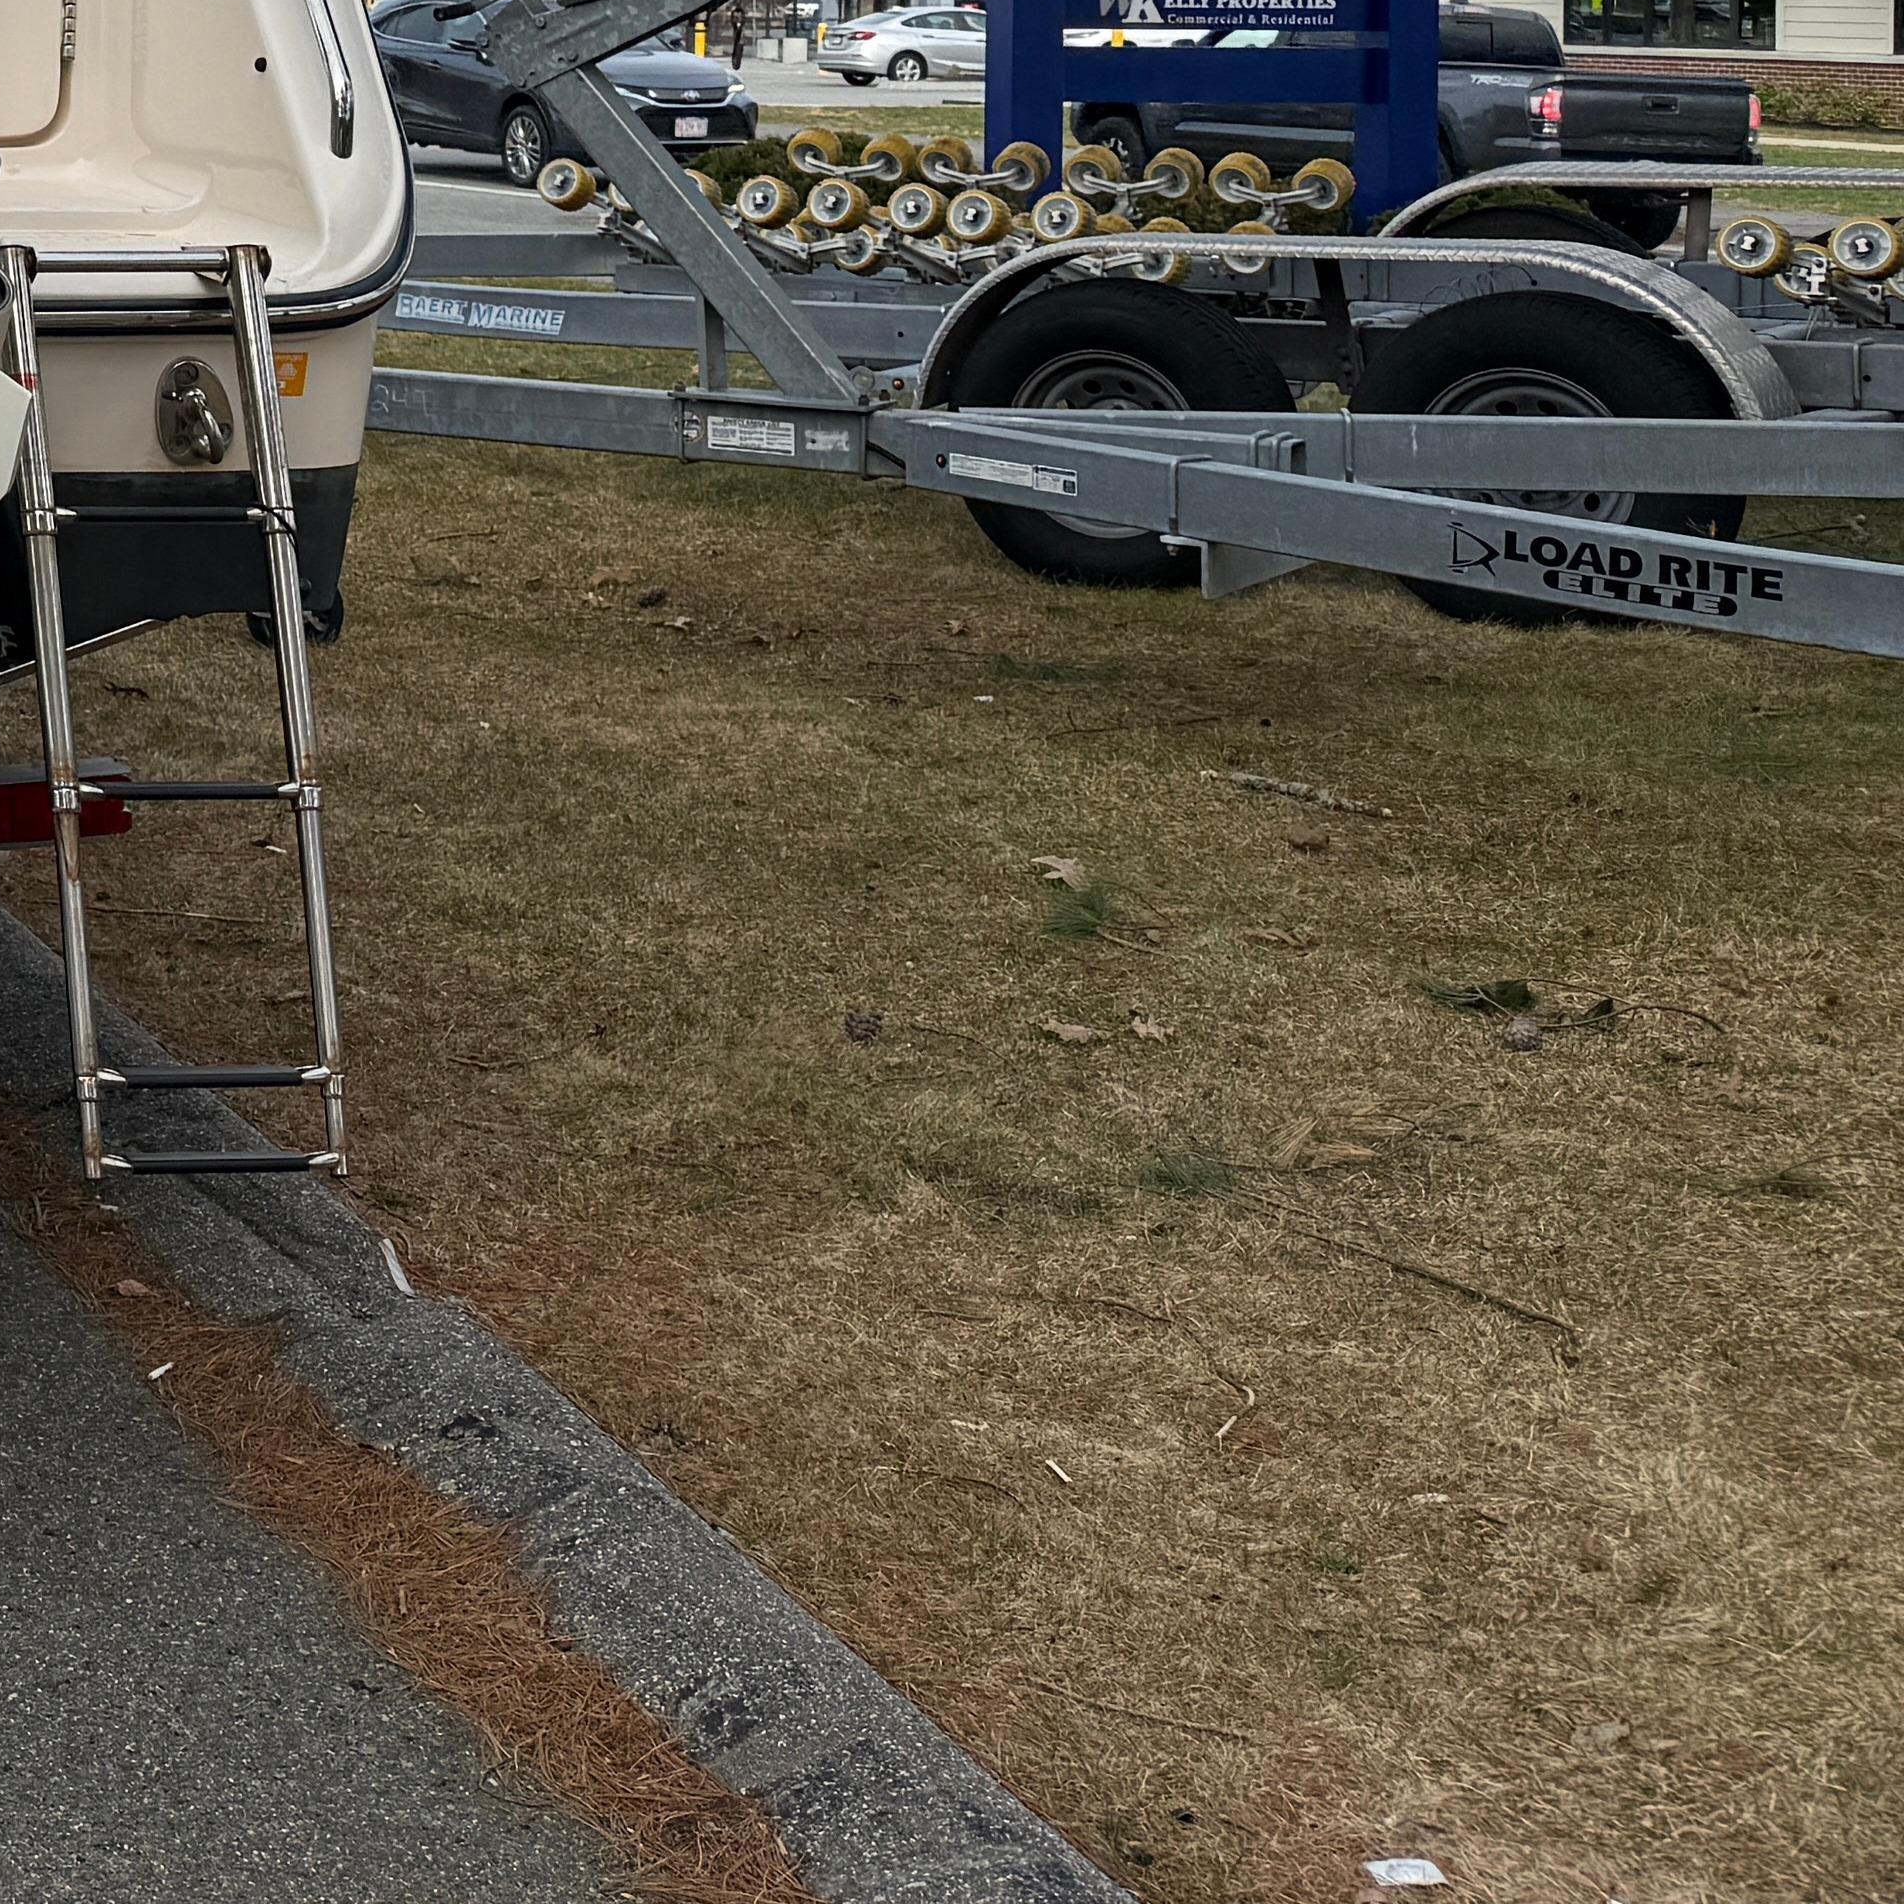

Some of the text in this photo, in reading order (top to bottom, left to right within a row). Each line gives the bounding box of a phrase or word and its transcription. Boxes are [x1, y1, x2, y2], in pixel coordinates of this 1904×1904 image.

[1166, 13, 1335, 26] Commercial & Residential
[397, 294, 469, 320] BAERT
[468, 302, 566, 329] MARINE
[1503, 530, 1784, 603] LOAD RITE
[1556, 573, 1723, 617] ELITE
